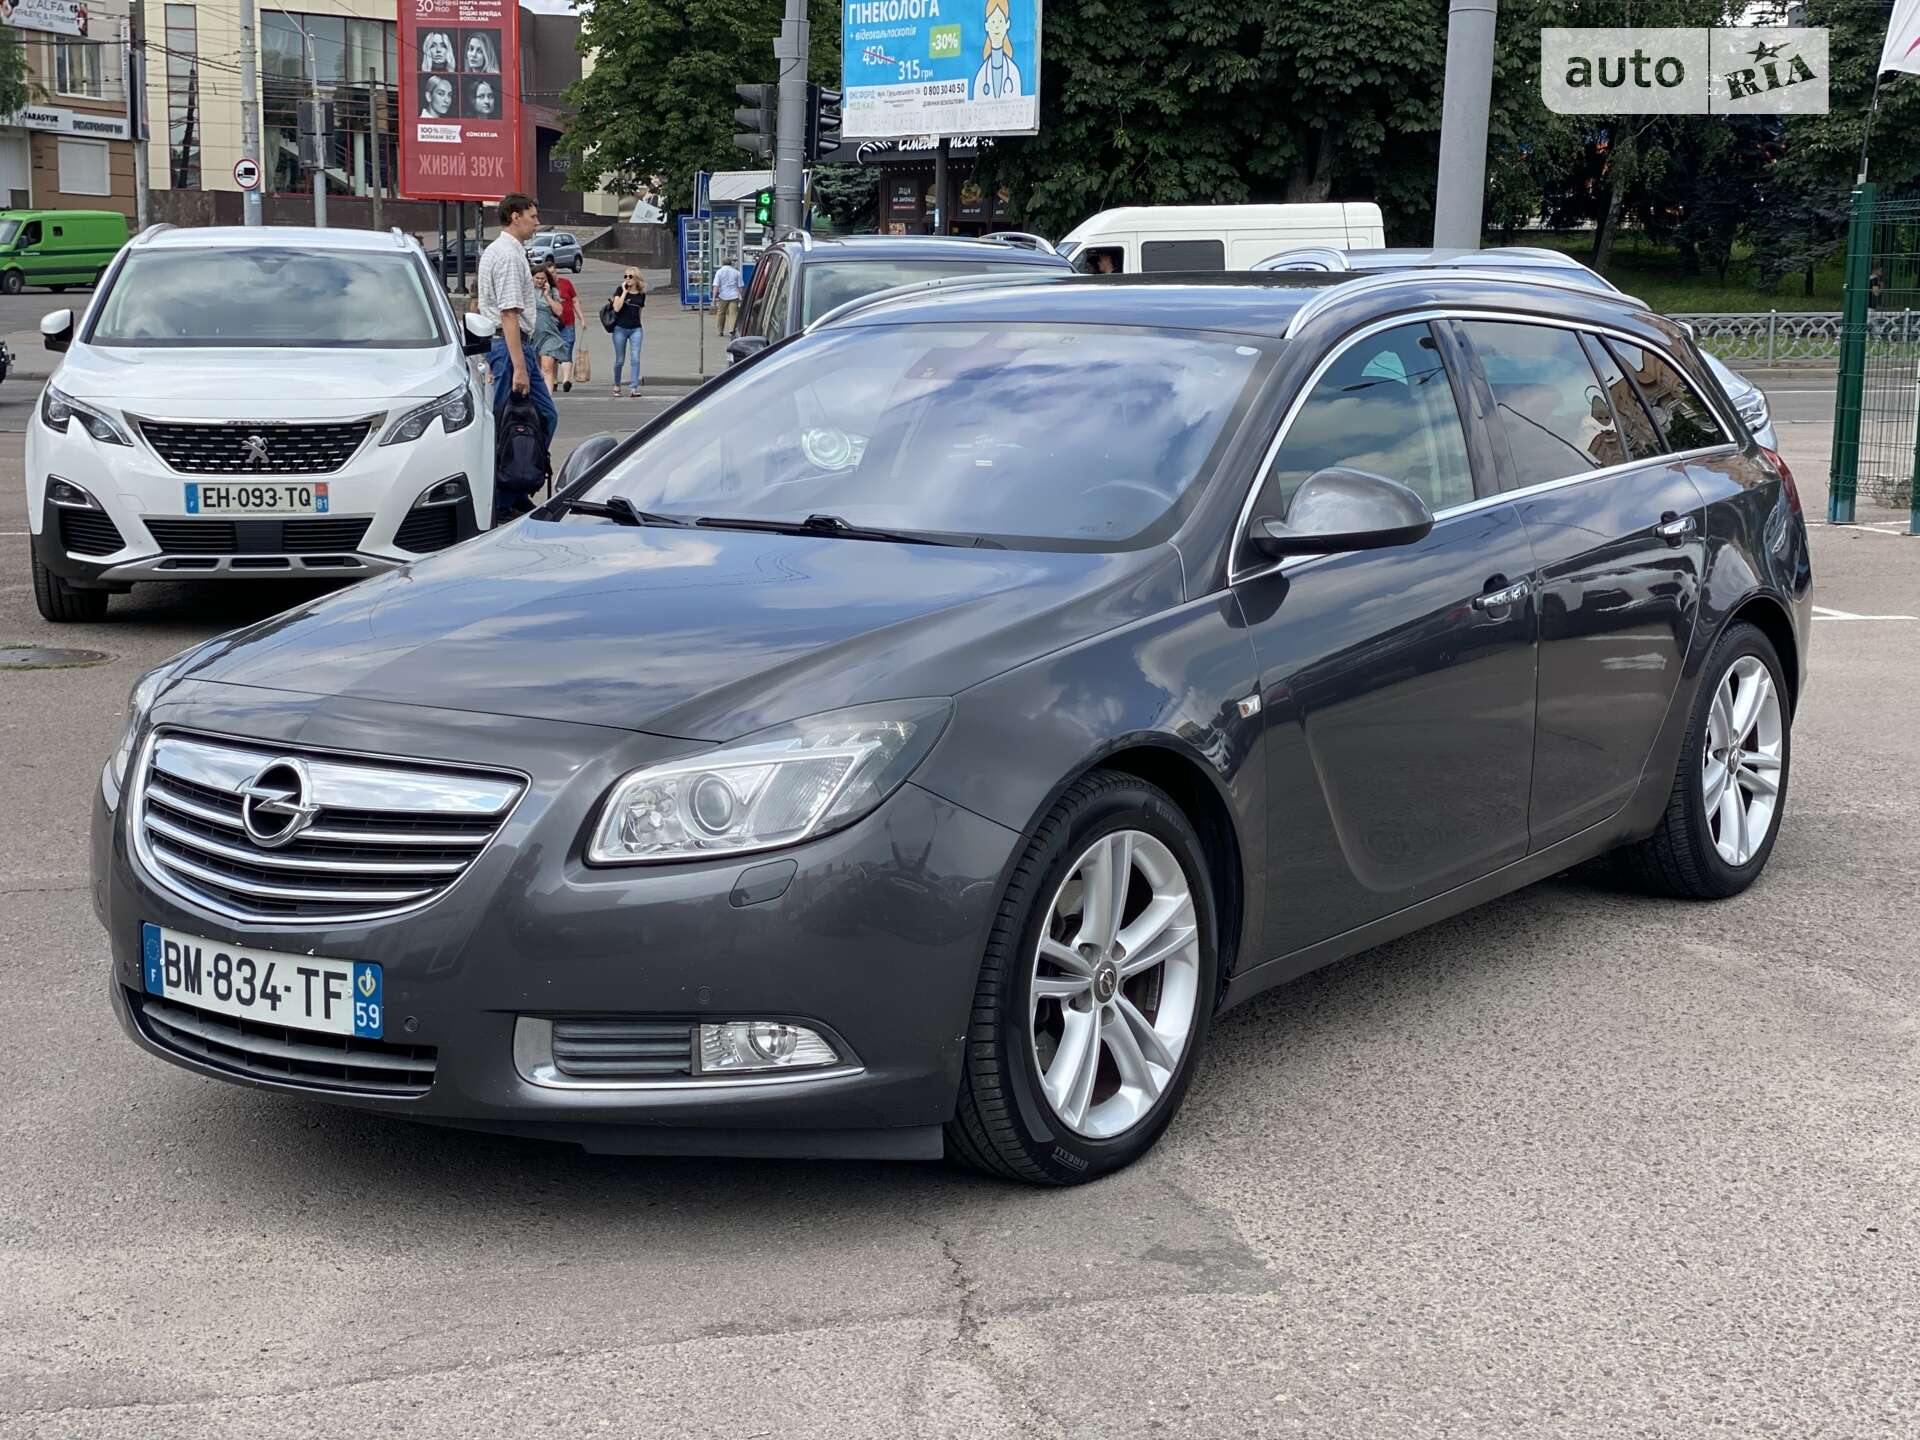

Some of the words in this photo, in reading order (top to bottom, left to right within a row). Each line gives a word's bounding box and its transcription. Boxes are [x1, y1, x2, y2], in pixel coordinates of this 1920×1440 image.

[416, 0, 434, 13] 30
[848, 0, 940, 25] ГІНЕКОЛОГА
[898, 59, 920, 80] 315
[418, 152, 467, 177] ЖИВИЙ
[470, 155, 504, 178] ЗВУК
[202, 487, 312, 508] EH-093-TQ
[163, 939, 348, 1020] BM-834-TF
[355, 1002, 381, 1029] 59
